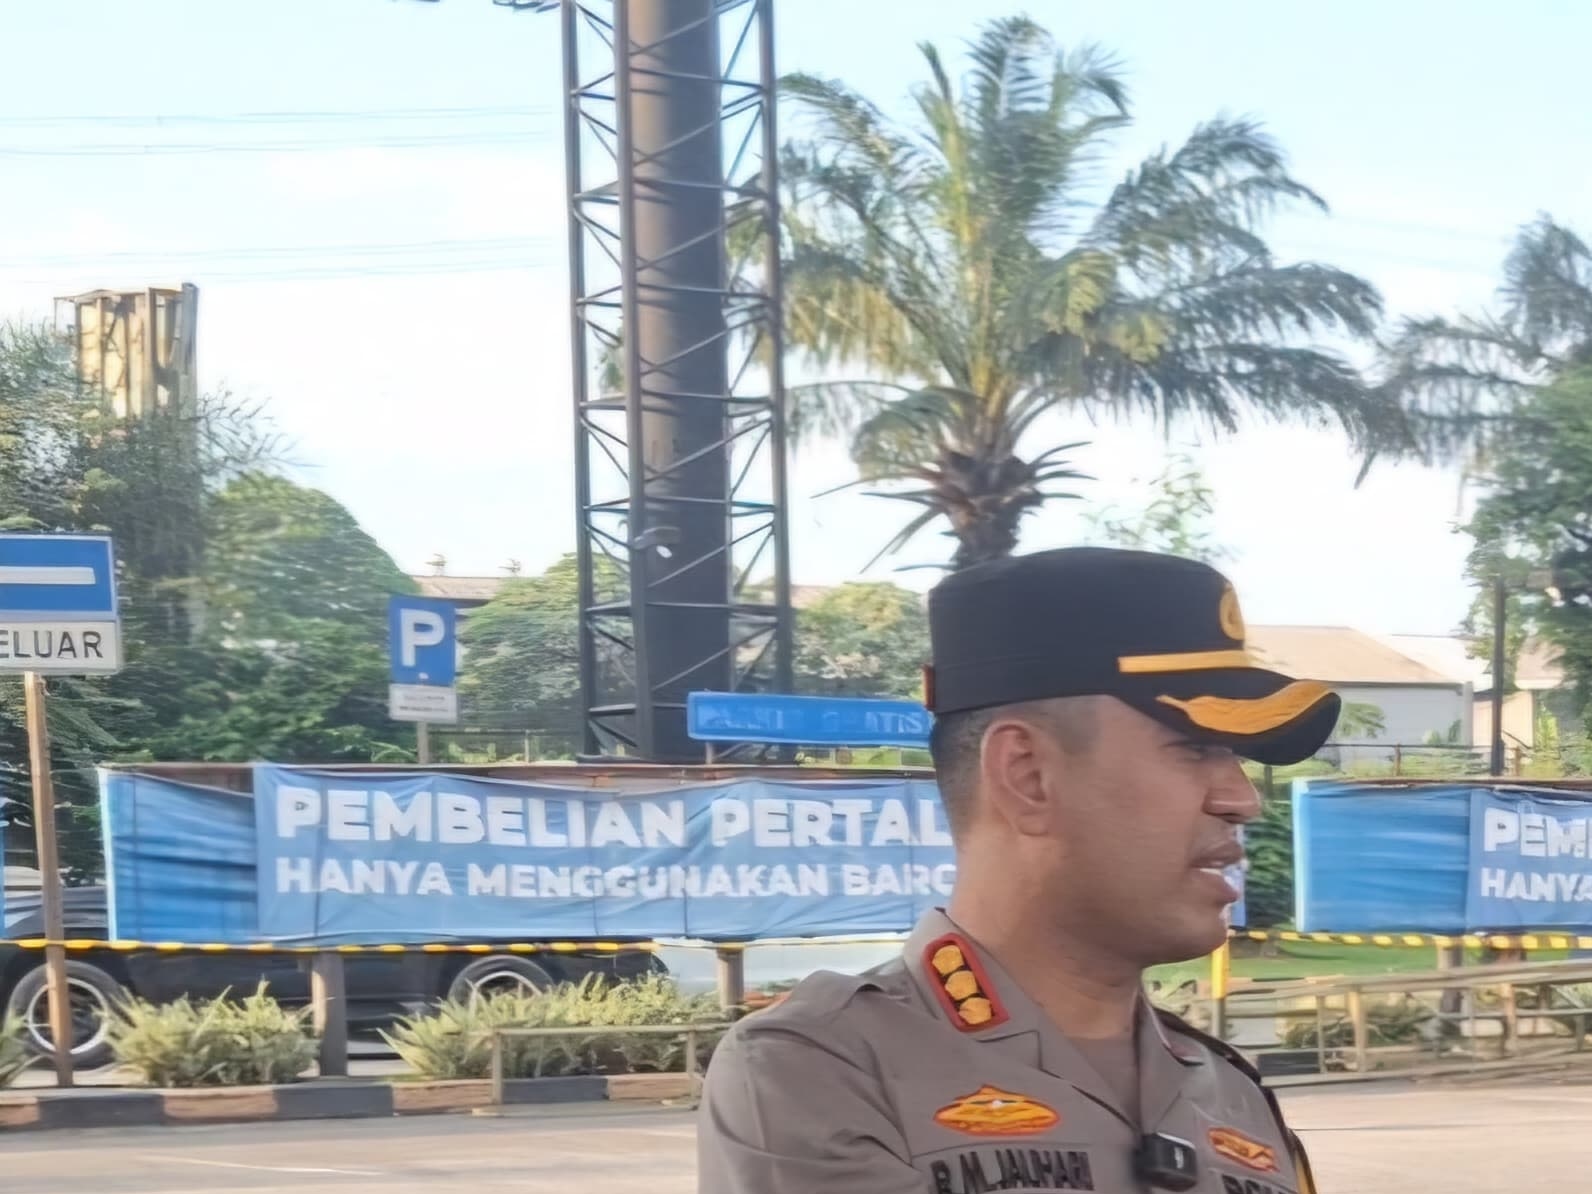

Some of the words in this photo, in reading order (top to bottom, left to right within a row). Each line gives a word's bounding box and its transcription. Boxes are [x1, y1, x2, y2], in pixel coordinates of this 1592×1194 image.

[400, 608, 445, 667] P
[276, 785, 685, 848] PEMBELIAN
[711, 798, 954, 848] PERTAL
[276, 856, 453, 896] HANYA
[467, 862, 829, 898] MENGGUNAKAN
[842, 862, 957, 897] BARC
